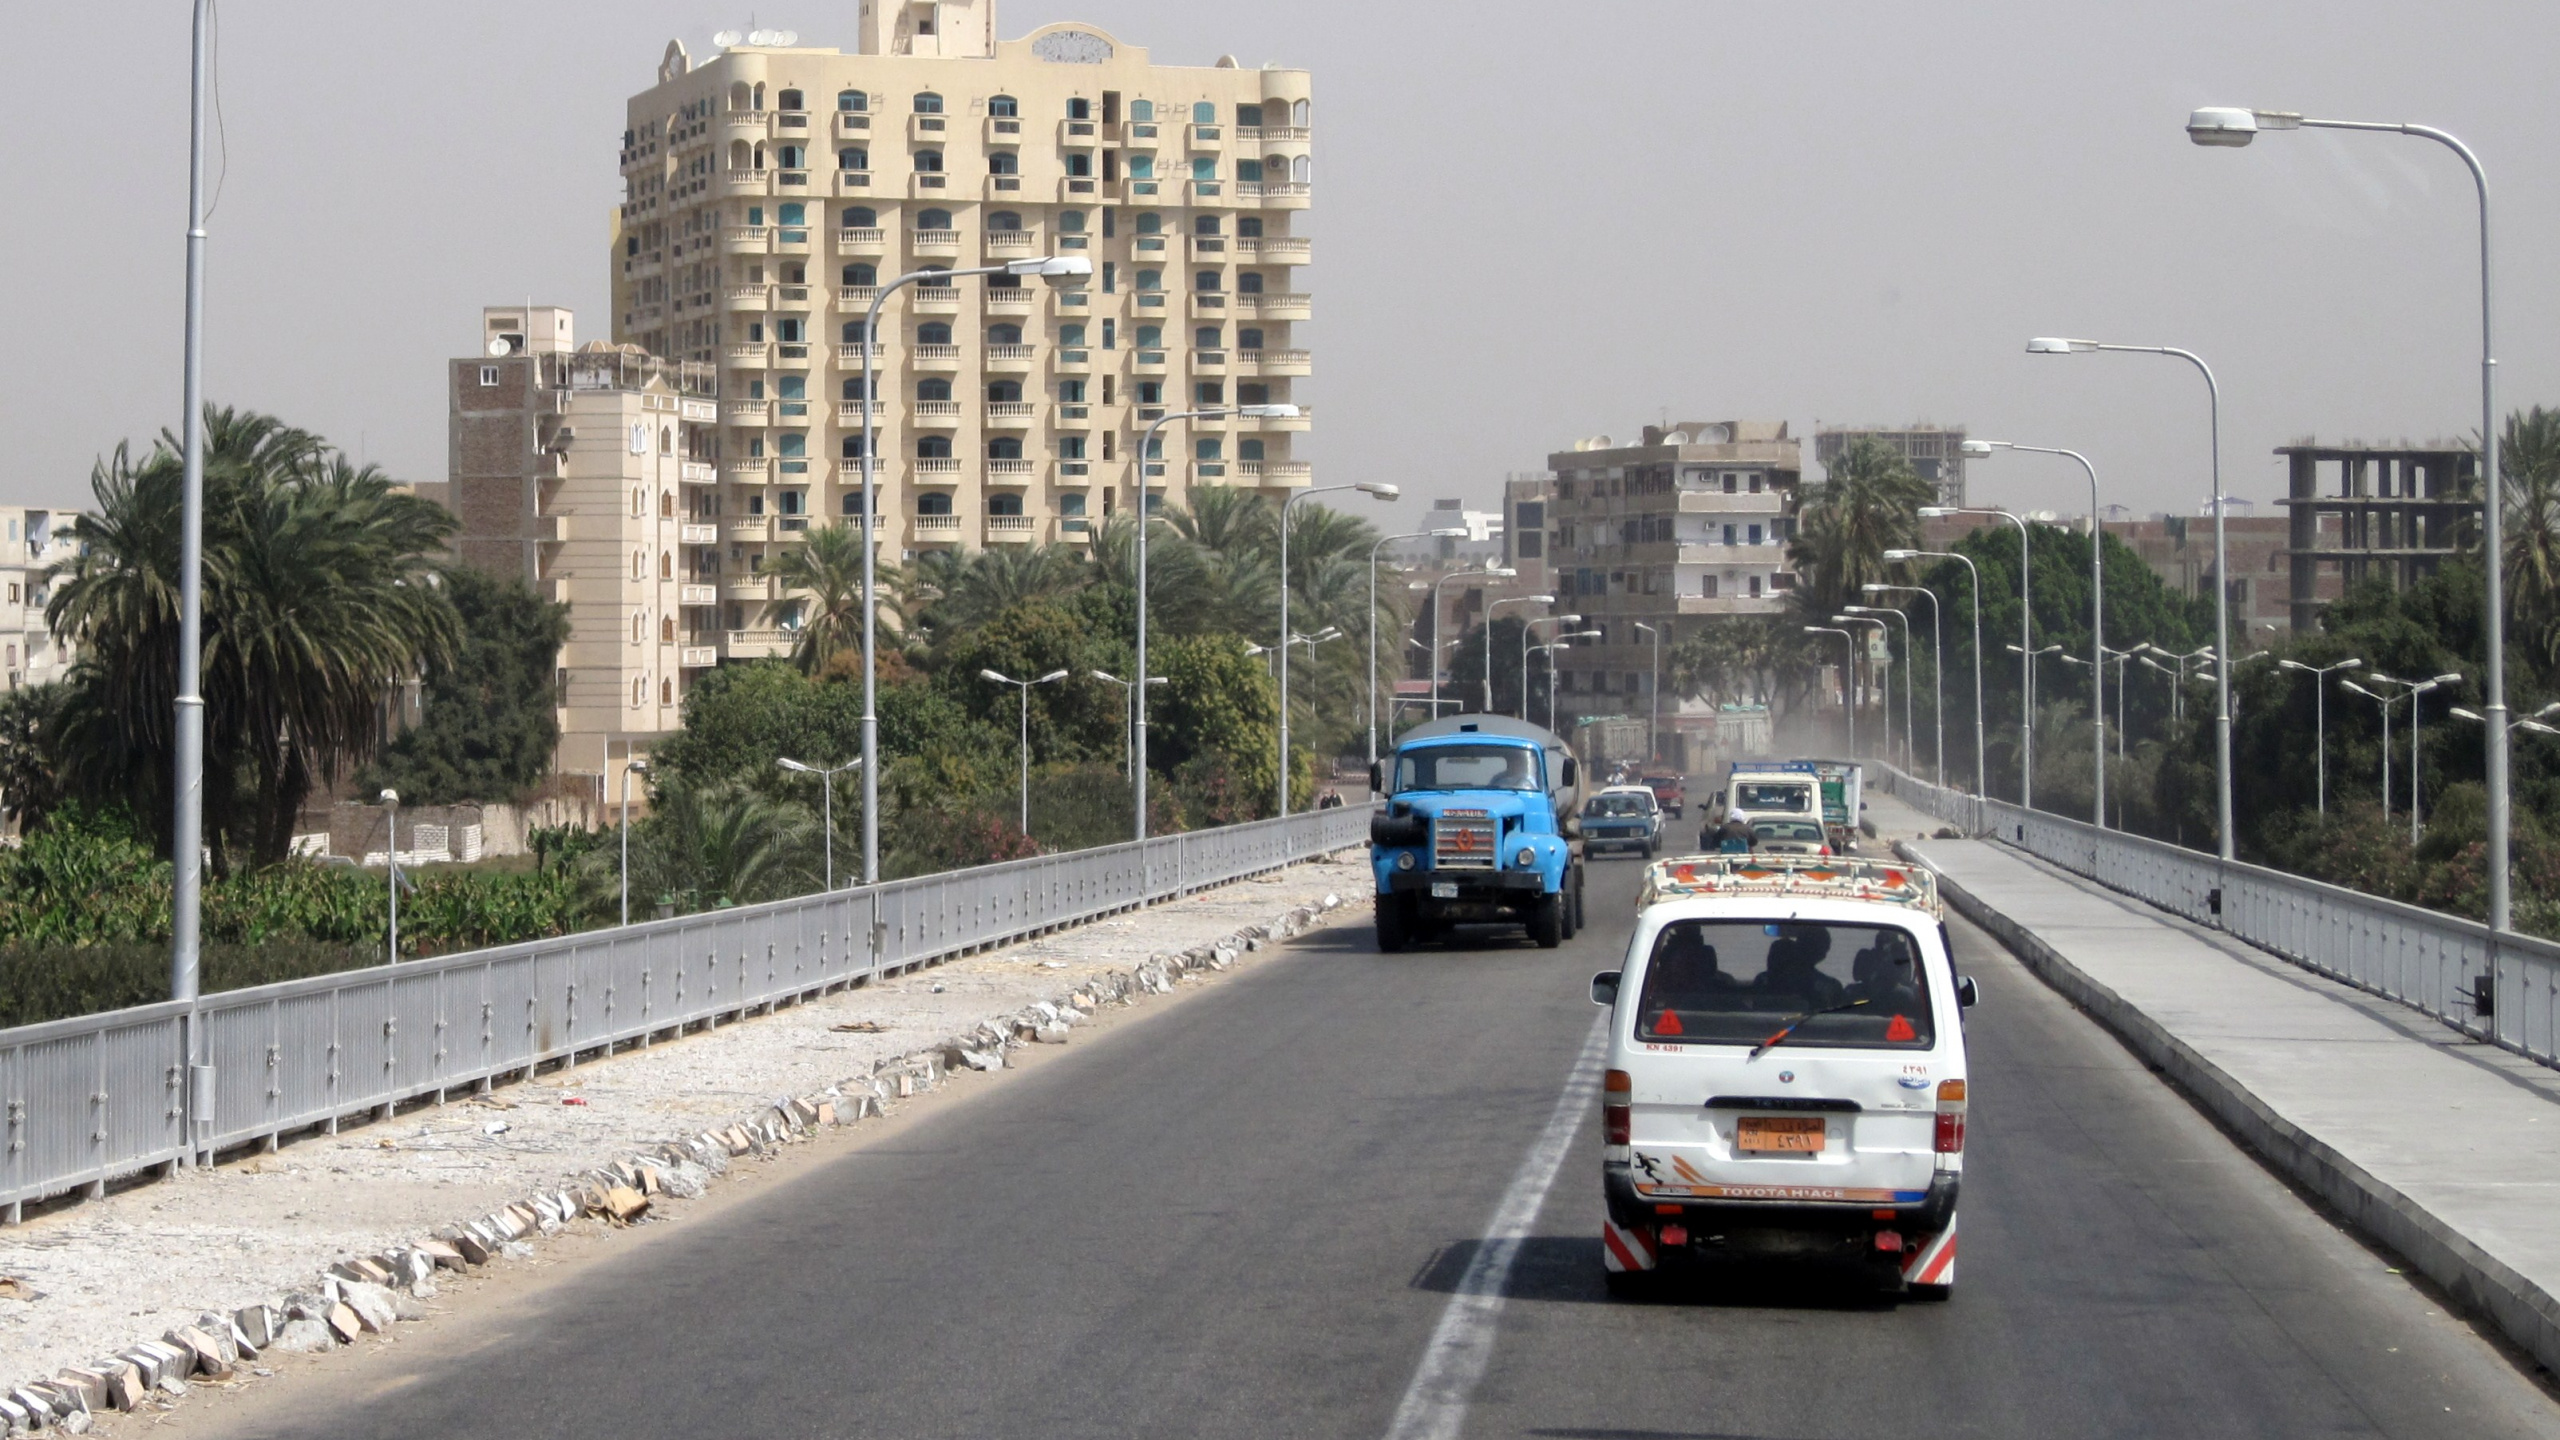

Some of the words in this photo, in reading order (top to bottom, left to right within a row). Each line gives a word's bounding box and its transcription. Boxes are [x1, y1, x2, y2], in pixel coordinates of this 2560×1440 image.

[1663, 1044, 1683, 1052] 4391
[1776, 1135, 1811, 1148] ٤٣٩١
[1720, 1187, 1787, 1198] TOYOTA
